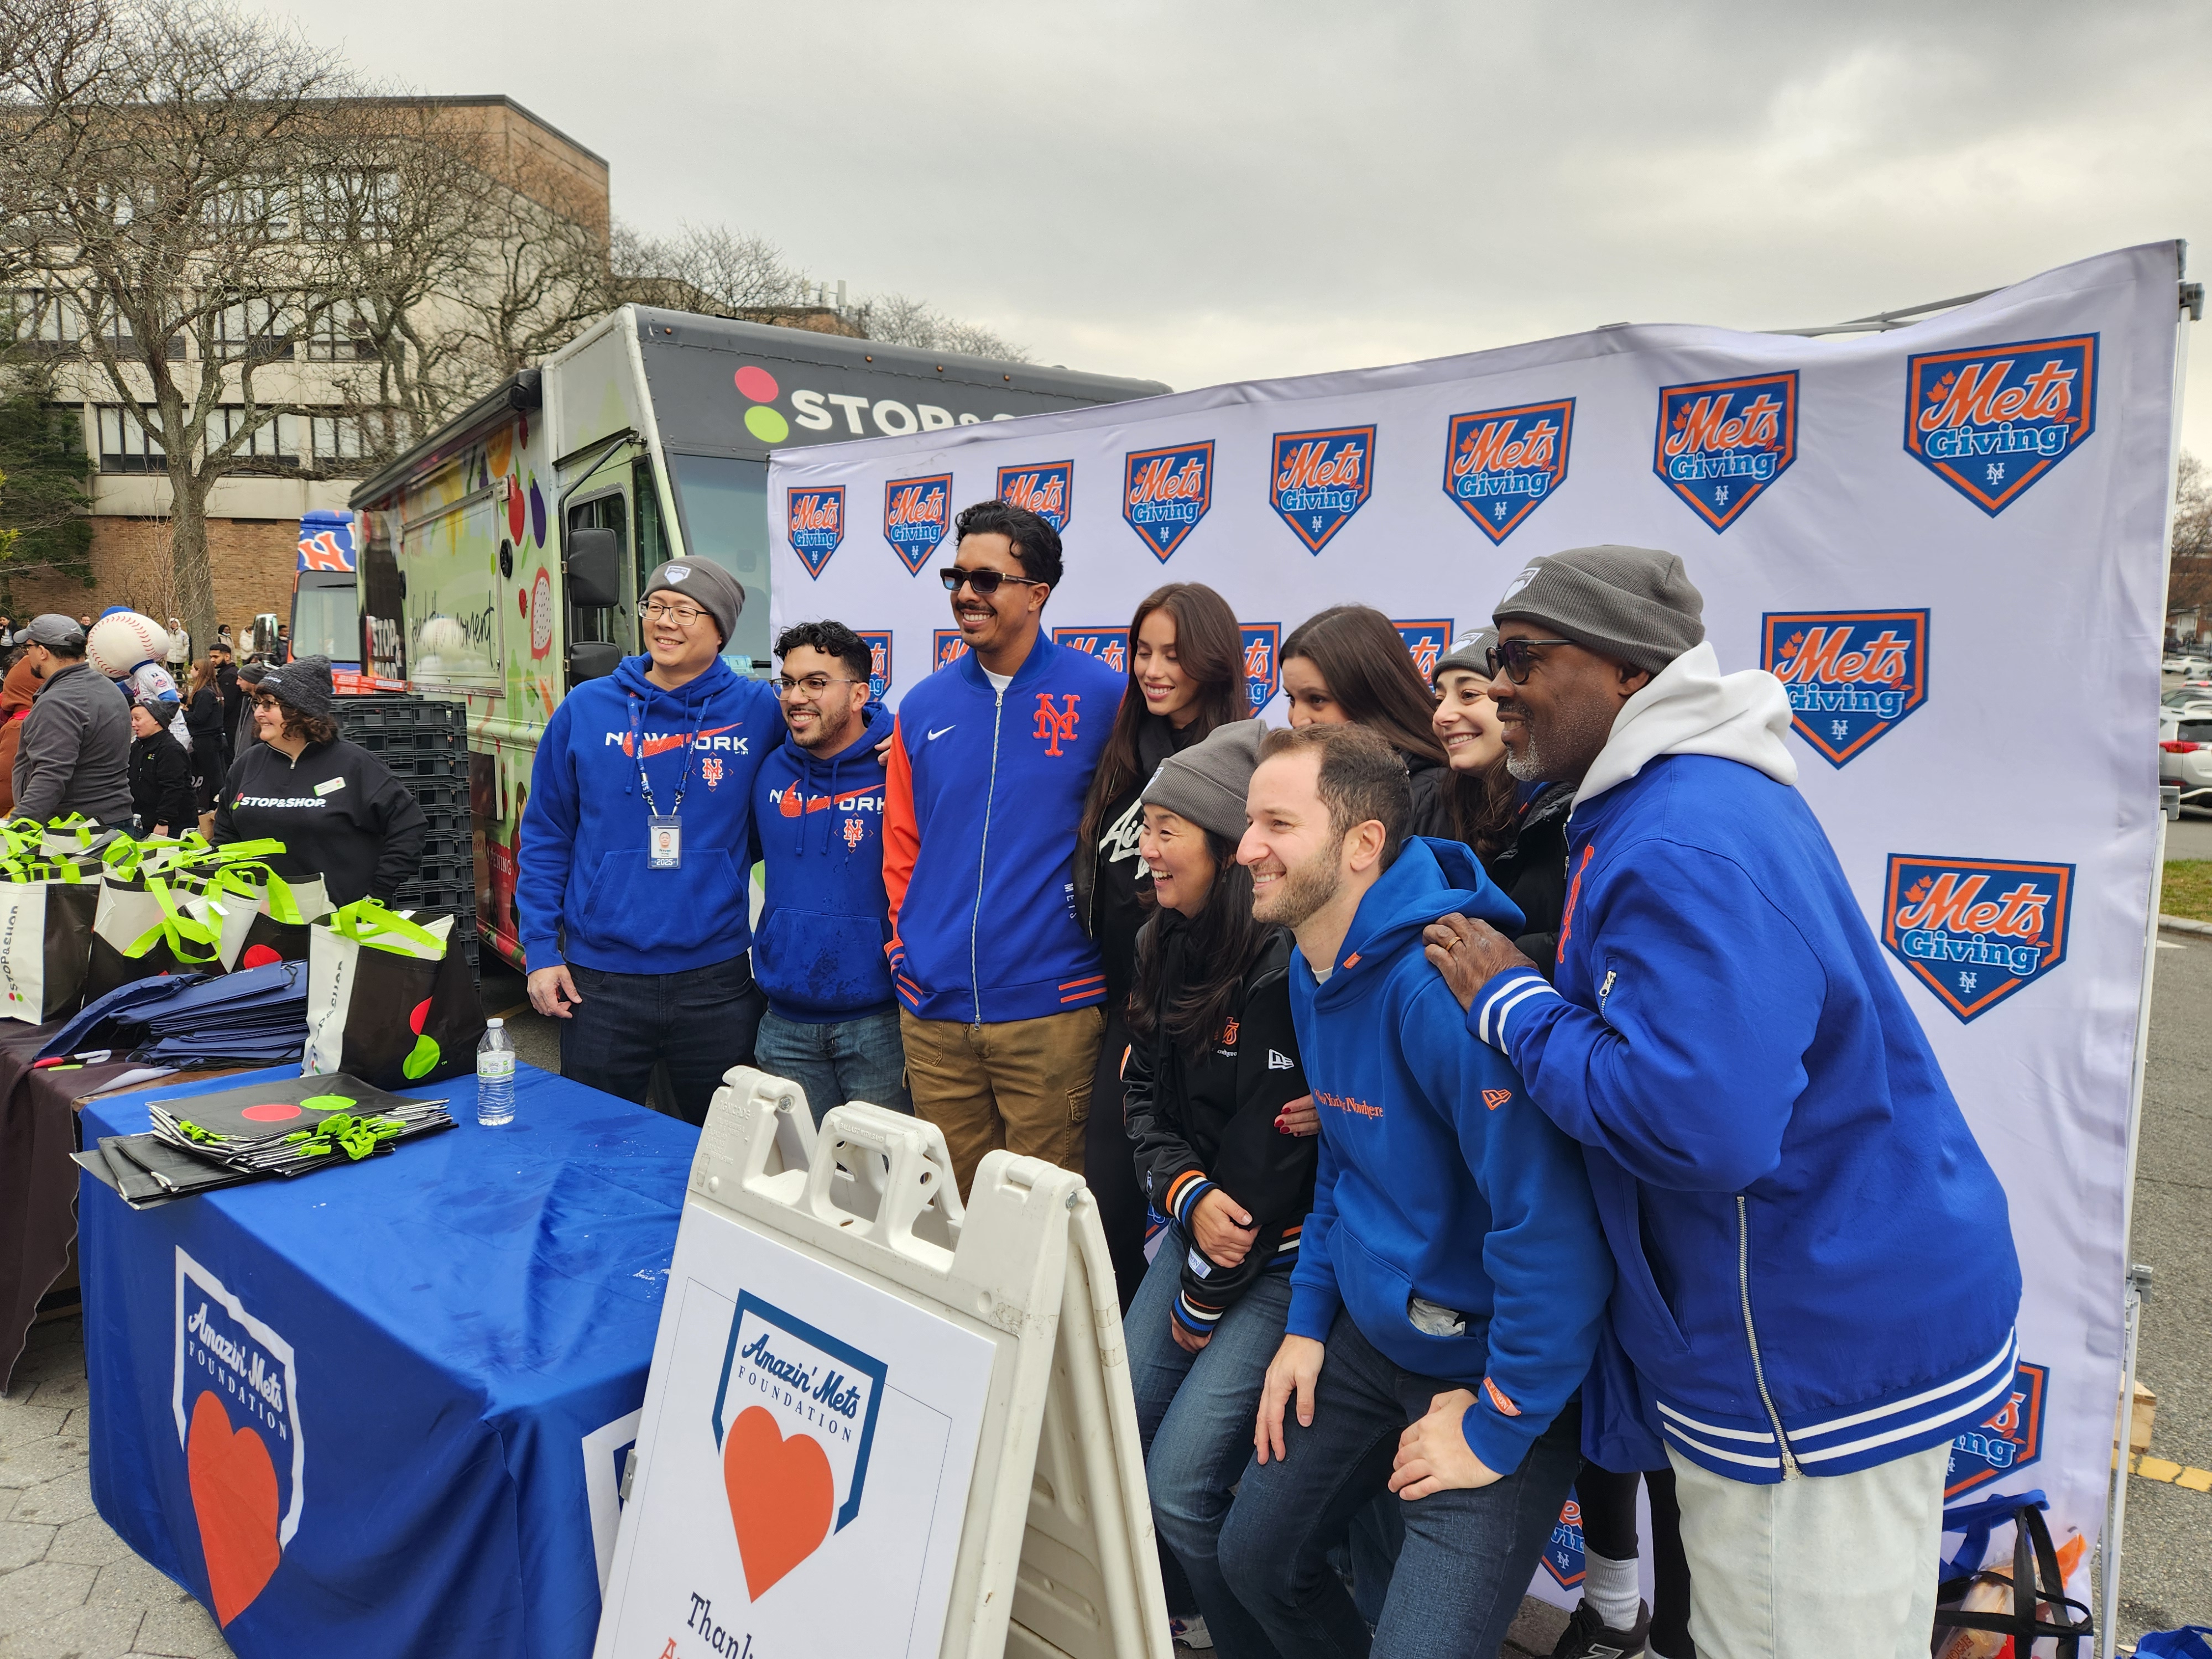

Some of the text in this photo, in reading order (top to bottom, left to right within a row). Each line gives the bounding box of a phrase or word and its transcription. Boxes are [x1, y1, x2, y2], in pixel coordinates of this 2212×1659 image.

[791, 389, 1016, 437] STOP
[1918, 359, 2078, 431] Mets
[1453, 419, 1559, 476] Mets
[1665, 393, 1782, 455] Mets
[1926, 421, 2069, 460] Giving
[1129, 457, 1205, 504] Mets
[1276, 441, 1364, 491] Mets
[1457, 469, 1550, 498] Giving
[1669, 448, 1777, 482] Giving
[791, 495, 839, 531] Mets
[889, 486, 945, 526] Mets
[1009, 473, 1065, 512] Mets
[1133, 498, 1199, 524] Giving
[1280, 485, 1358, 513] Giving
[794, 528, 837, 549] Giving
[891, 521, 941, 544] Giving
[1772, 627, 1912, 684] Mets
[1783, 682, 1905, 719] Giving
[240, 796, 326, 808] STOP&SHOP
[1896, 873, 2052, 938] Mets
[1902, 929, 2040, 976] Giving
[188, 1302, 283, 1413] Amazin' Mets
[741, 1333, 861, 1420] Amazin' Mets
[189, 1340, 287, 1441] FOUNDATION
[738, 1365, 852, 1443] FOUNDATION
